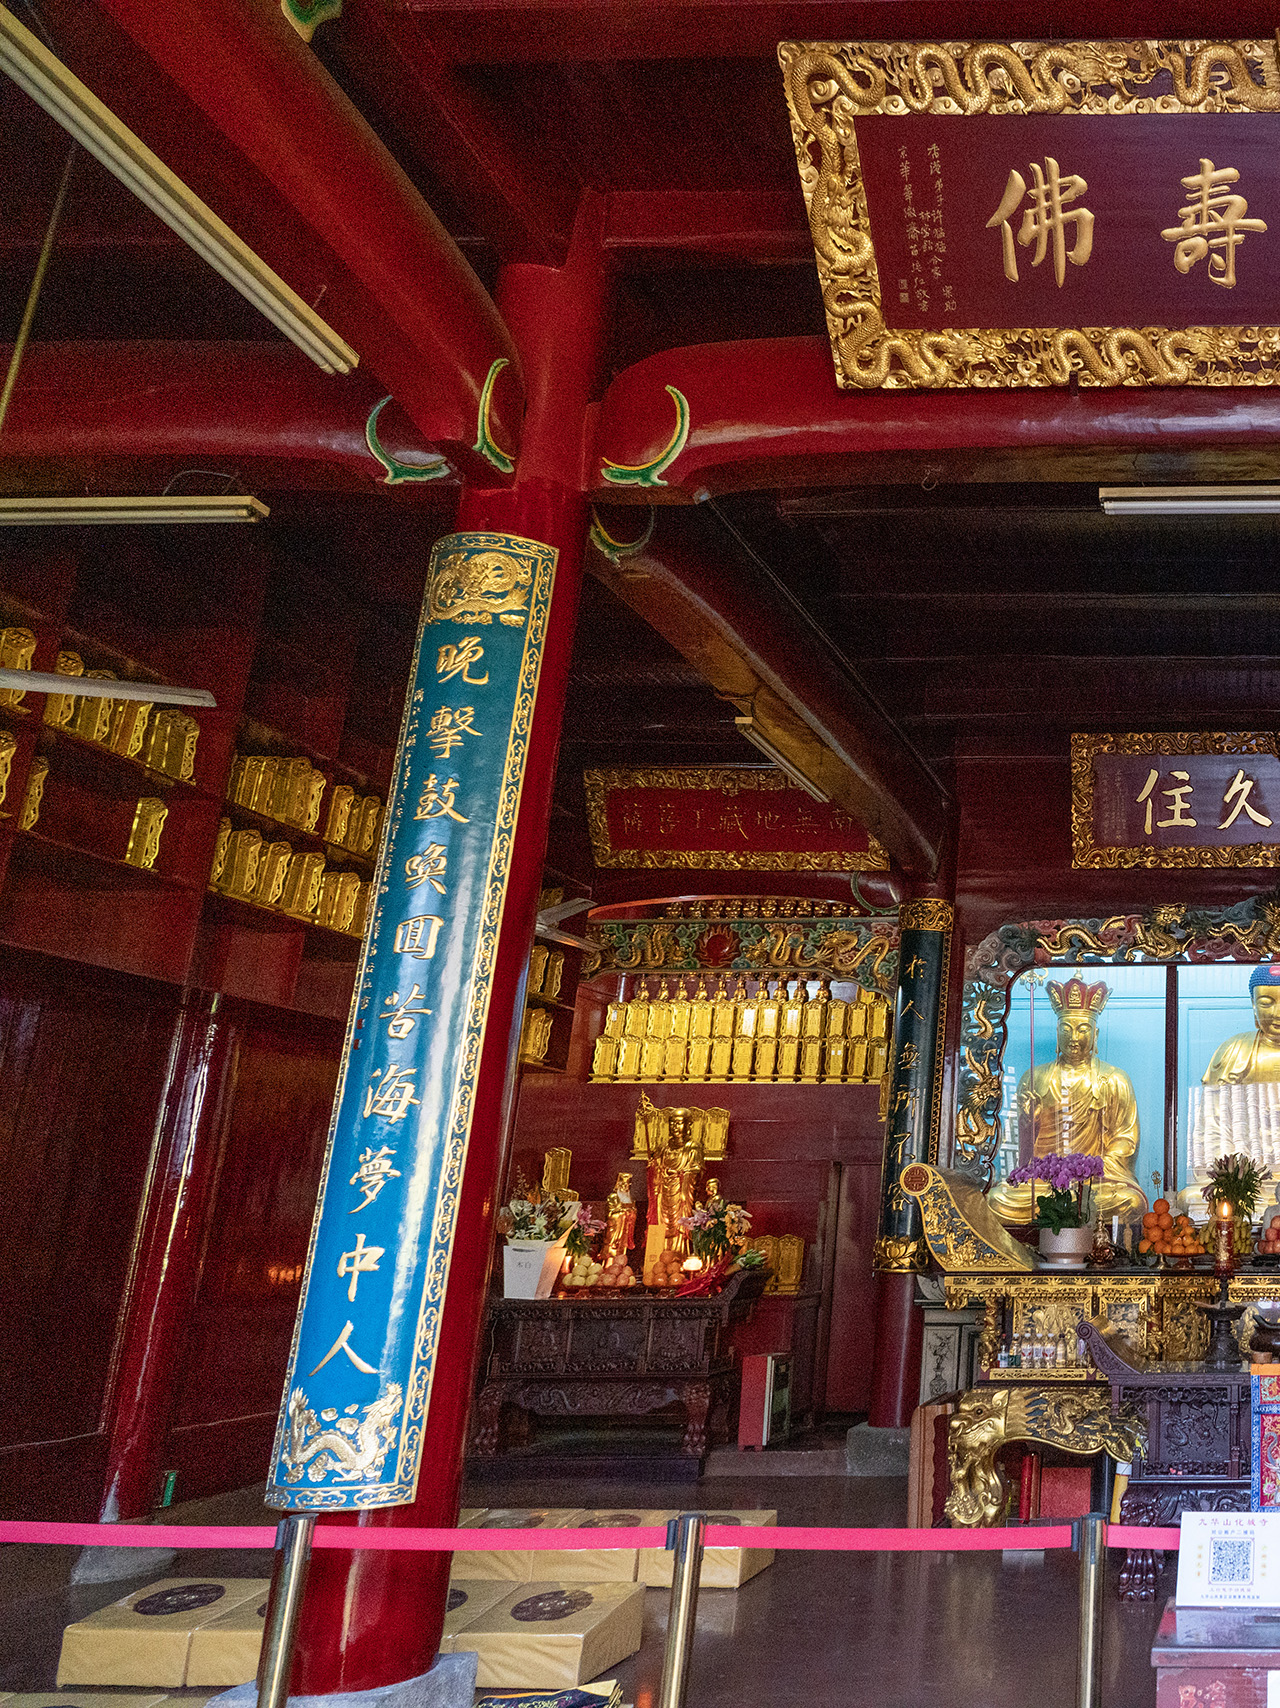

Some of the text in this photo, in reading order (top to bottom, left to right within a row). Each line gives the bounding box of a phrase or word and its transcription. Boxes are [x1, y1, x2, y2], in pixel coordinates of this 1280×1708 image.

[1198, 1518, 1268, 1527] 九华山化城寺
